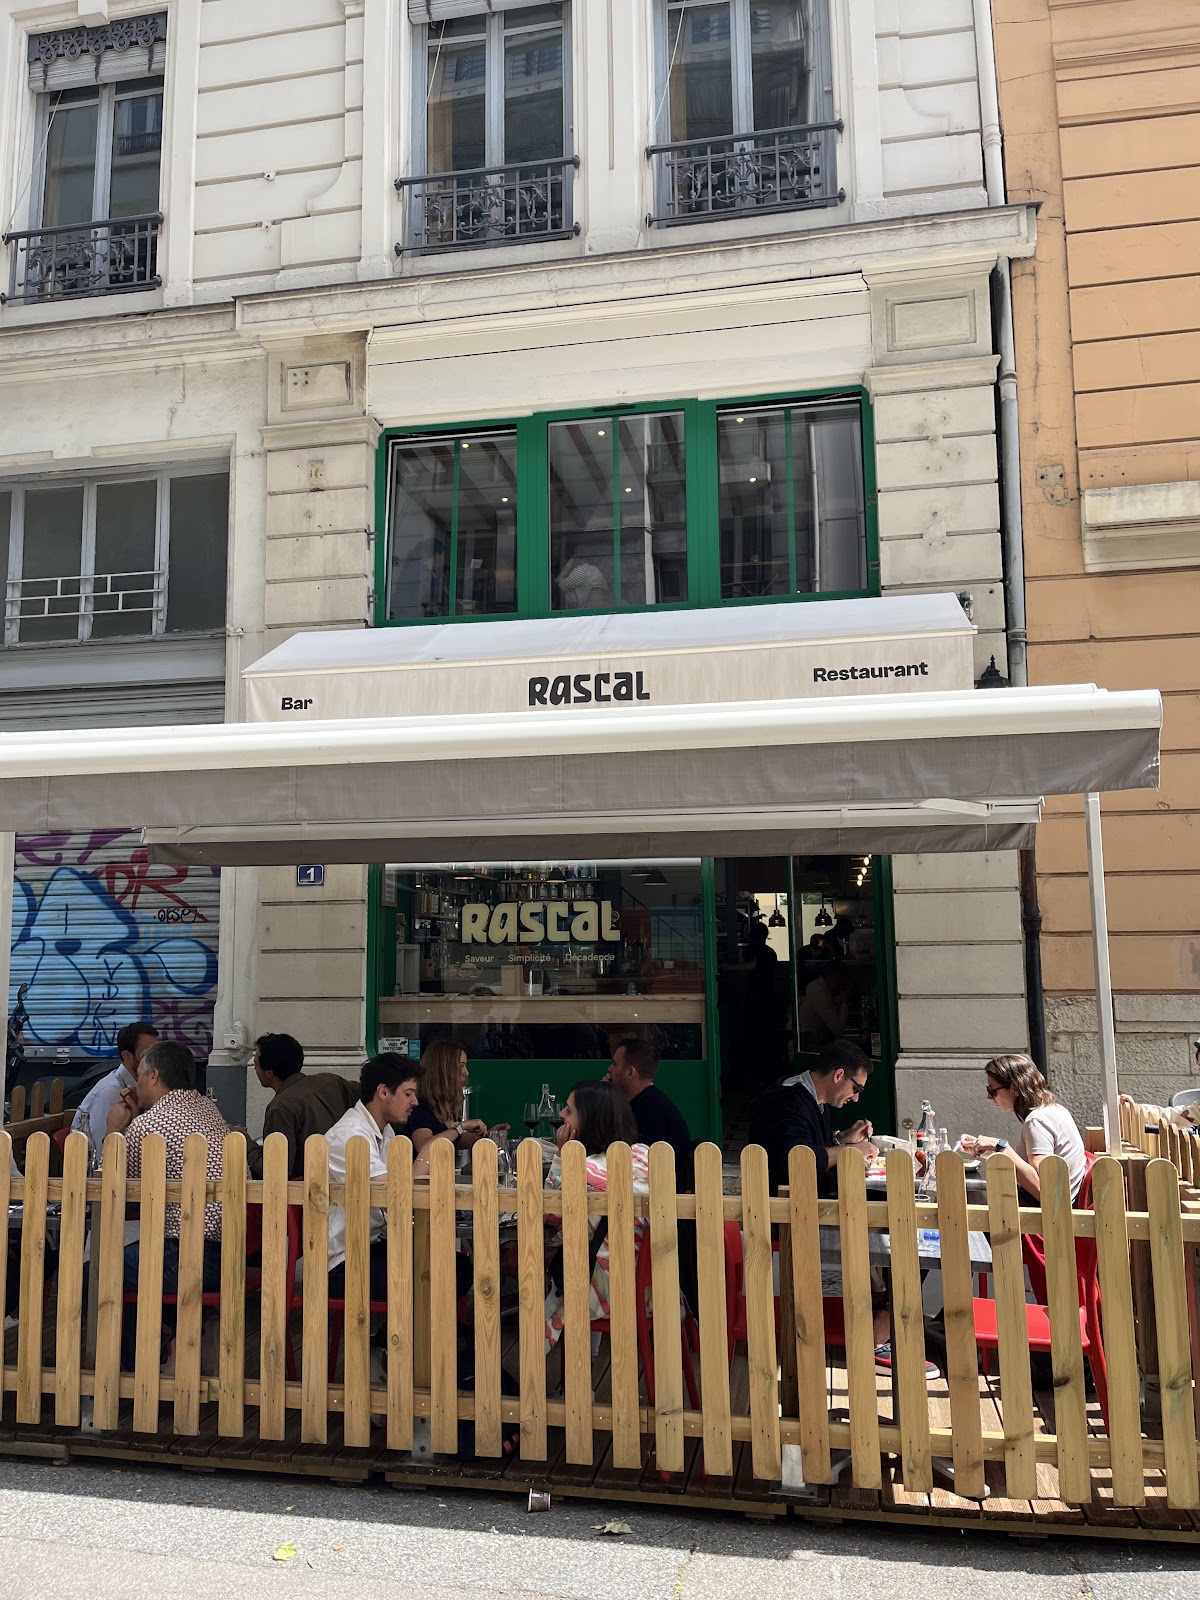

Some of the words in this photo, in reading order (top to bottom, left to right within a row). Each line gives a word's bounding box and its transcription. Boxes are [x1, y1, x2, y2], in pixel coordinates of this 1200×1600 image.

[813, 661, 928, 683] Restaurant
[281, 697, 312, 711] Bar
[306, 867, 315, 881] 1
[464, 954, 494, 963] Saveur
[508, 953, 552, 964] Simplicité
[565, 952, 615, 962] Décadence
